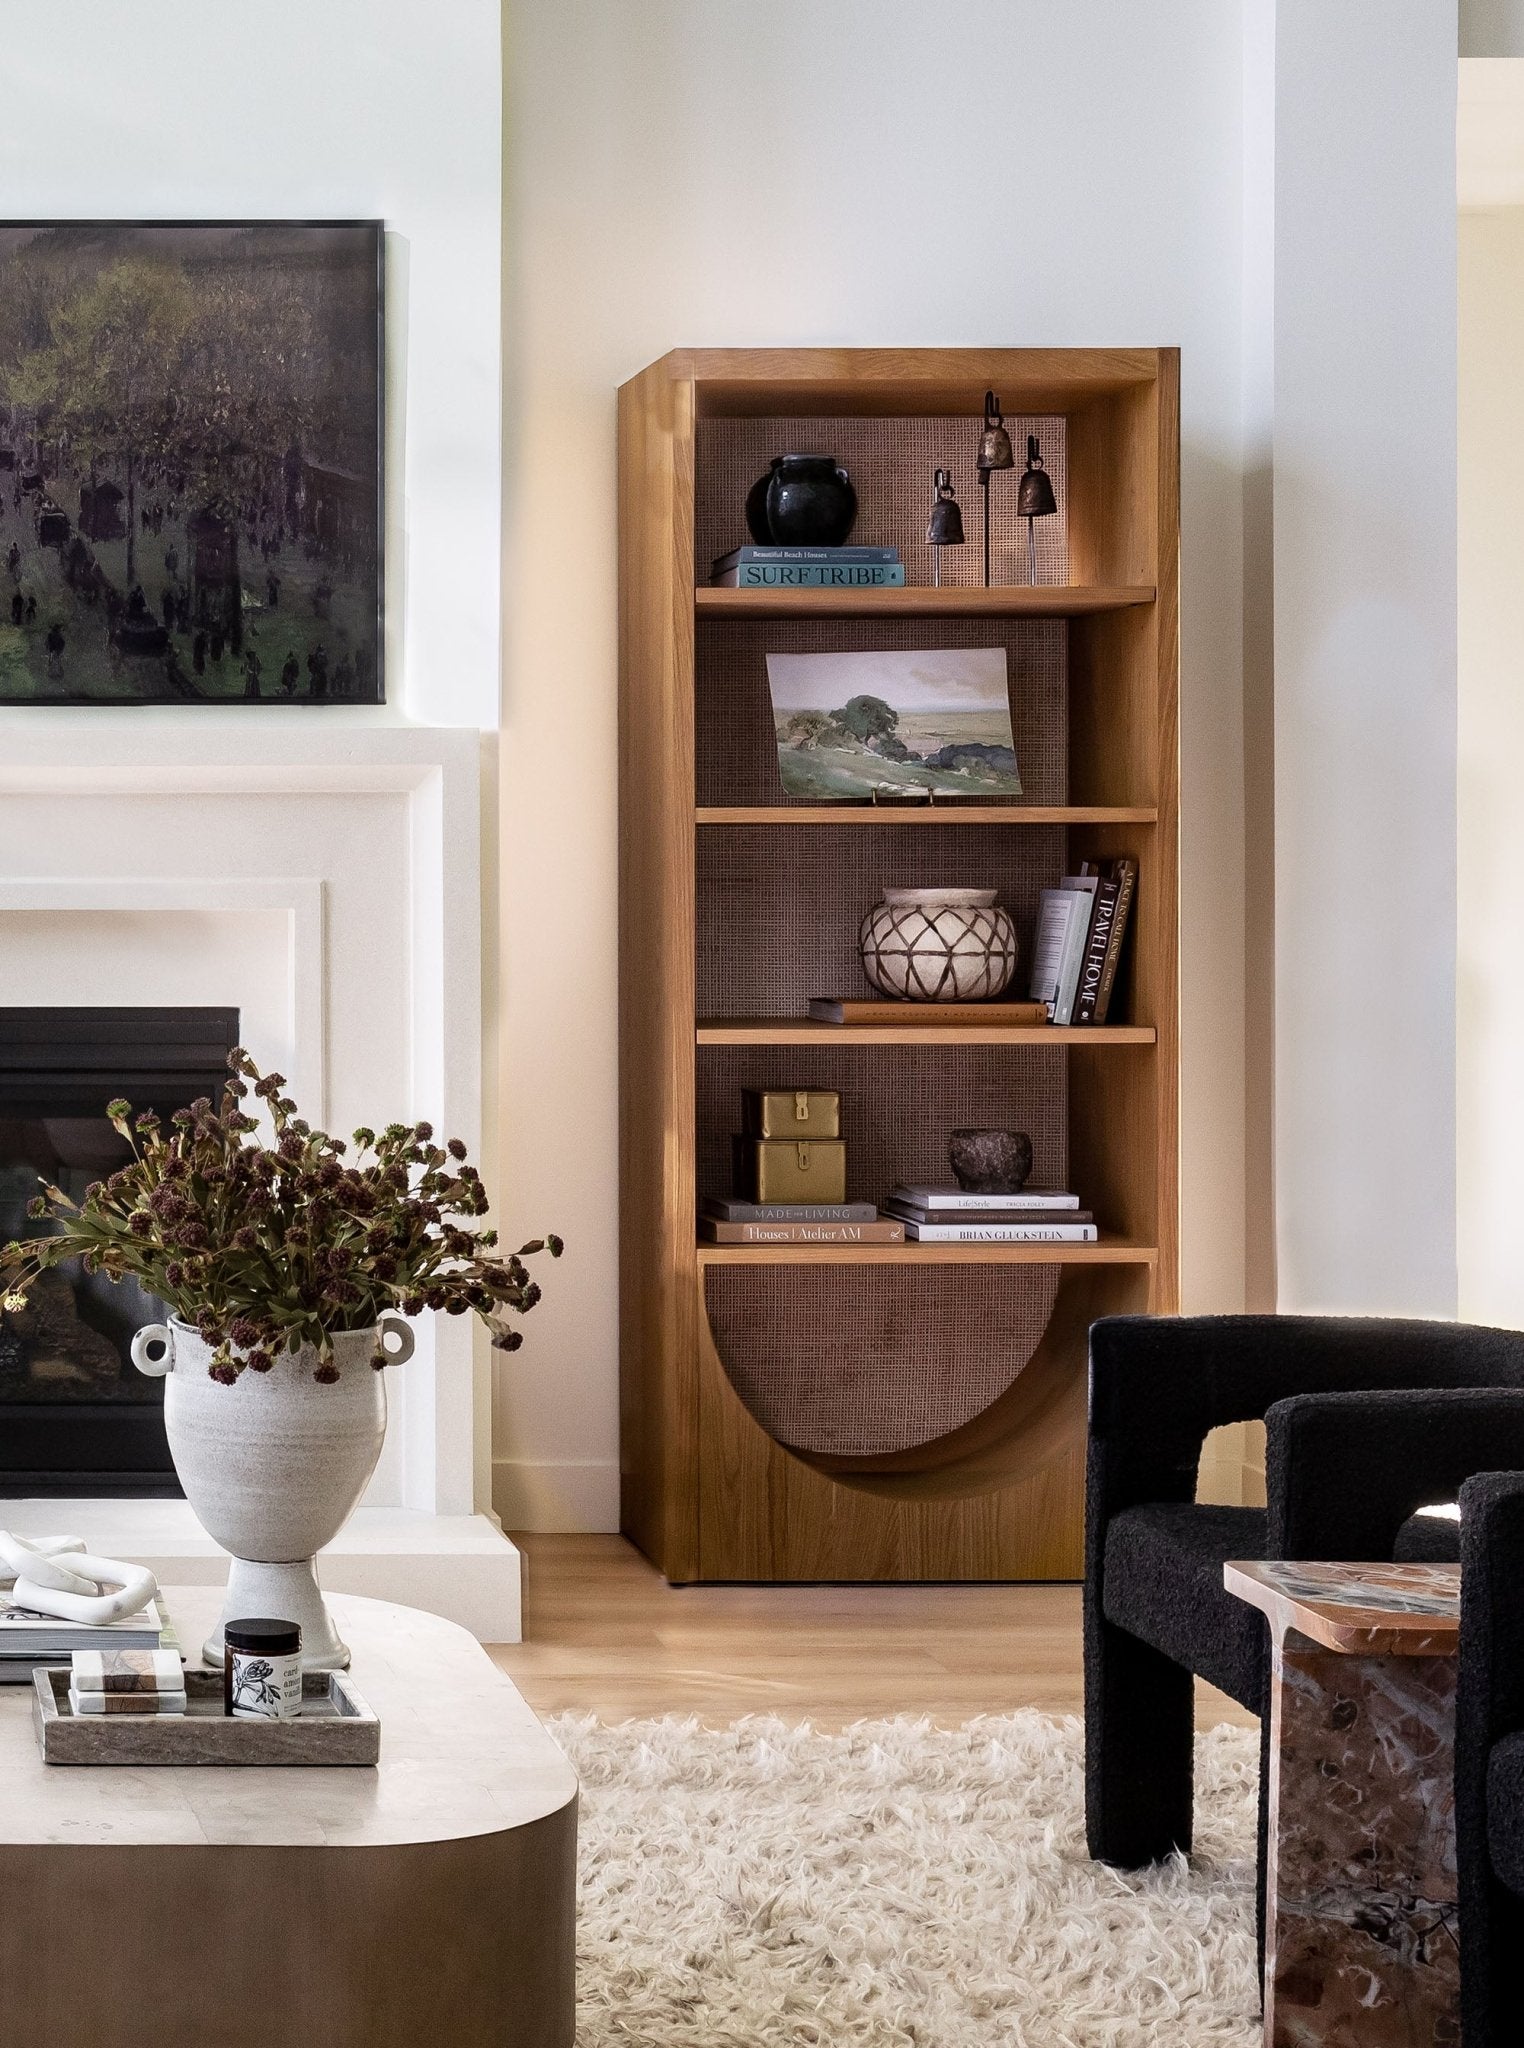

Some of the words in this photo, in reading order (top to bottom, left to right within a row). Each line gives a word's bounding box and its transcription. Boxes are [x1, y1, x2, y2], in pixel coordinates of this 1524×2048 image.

[752, 550, 783, 558] Beautiful
[747, 566, 812, 584] SURF
[815, 567, 884, 585] TRIBE
[1119, 905, 1127, 915] TO
[1091, 899, 1115, 950] TRAVEL
[1108, 938, 1120, 961] HOME
[1080, 955, 1103, 1005] HOME
[754, 1209, 792, 1219] MADE
[805, 1209, 850, 1218] LIVING
[749, 1227, 789, 1239] Houses
[799, 1227, 836, 1239] Atelier
[839, 1227, 861, 1239] AM
[959, 1231, 992, 1240] BRIAN
[994, 1231, 1064, 1240] GLUCKSTEIN
